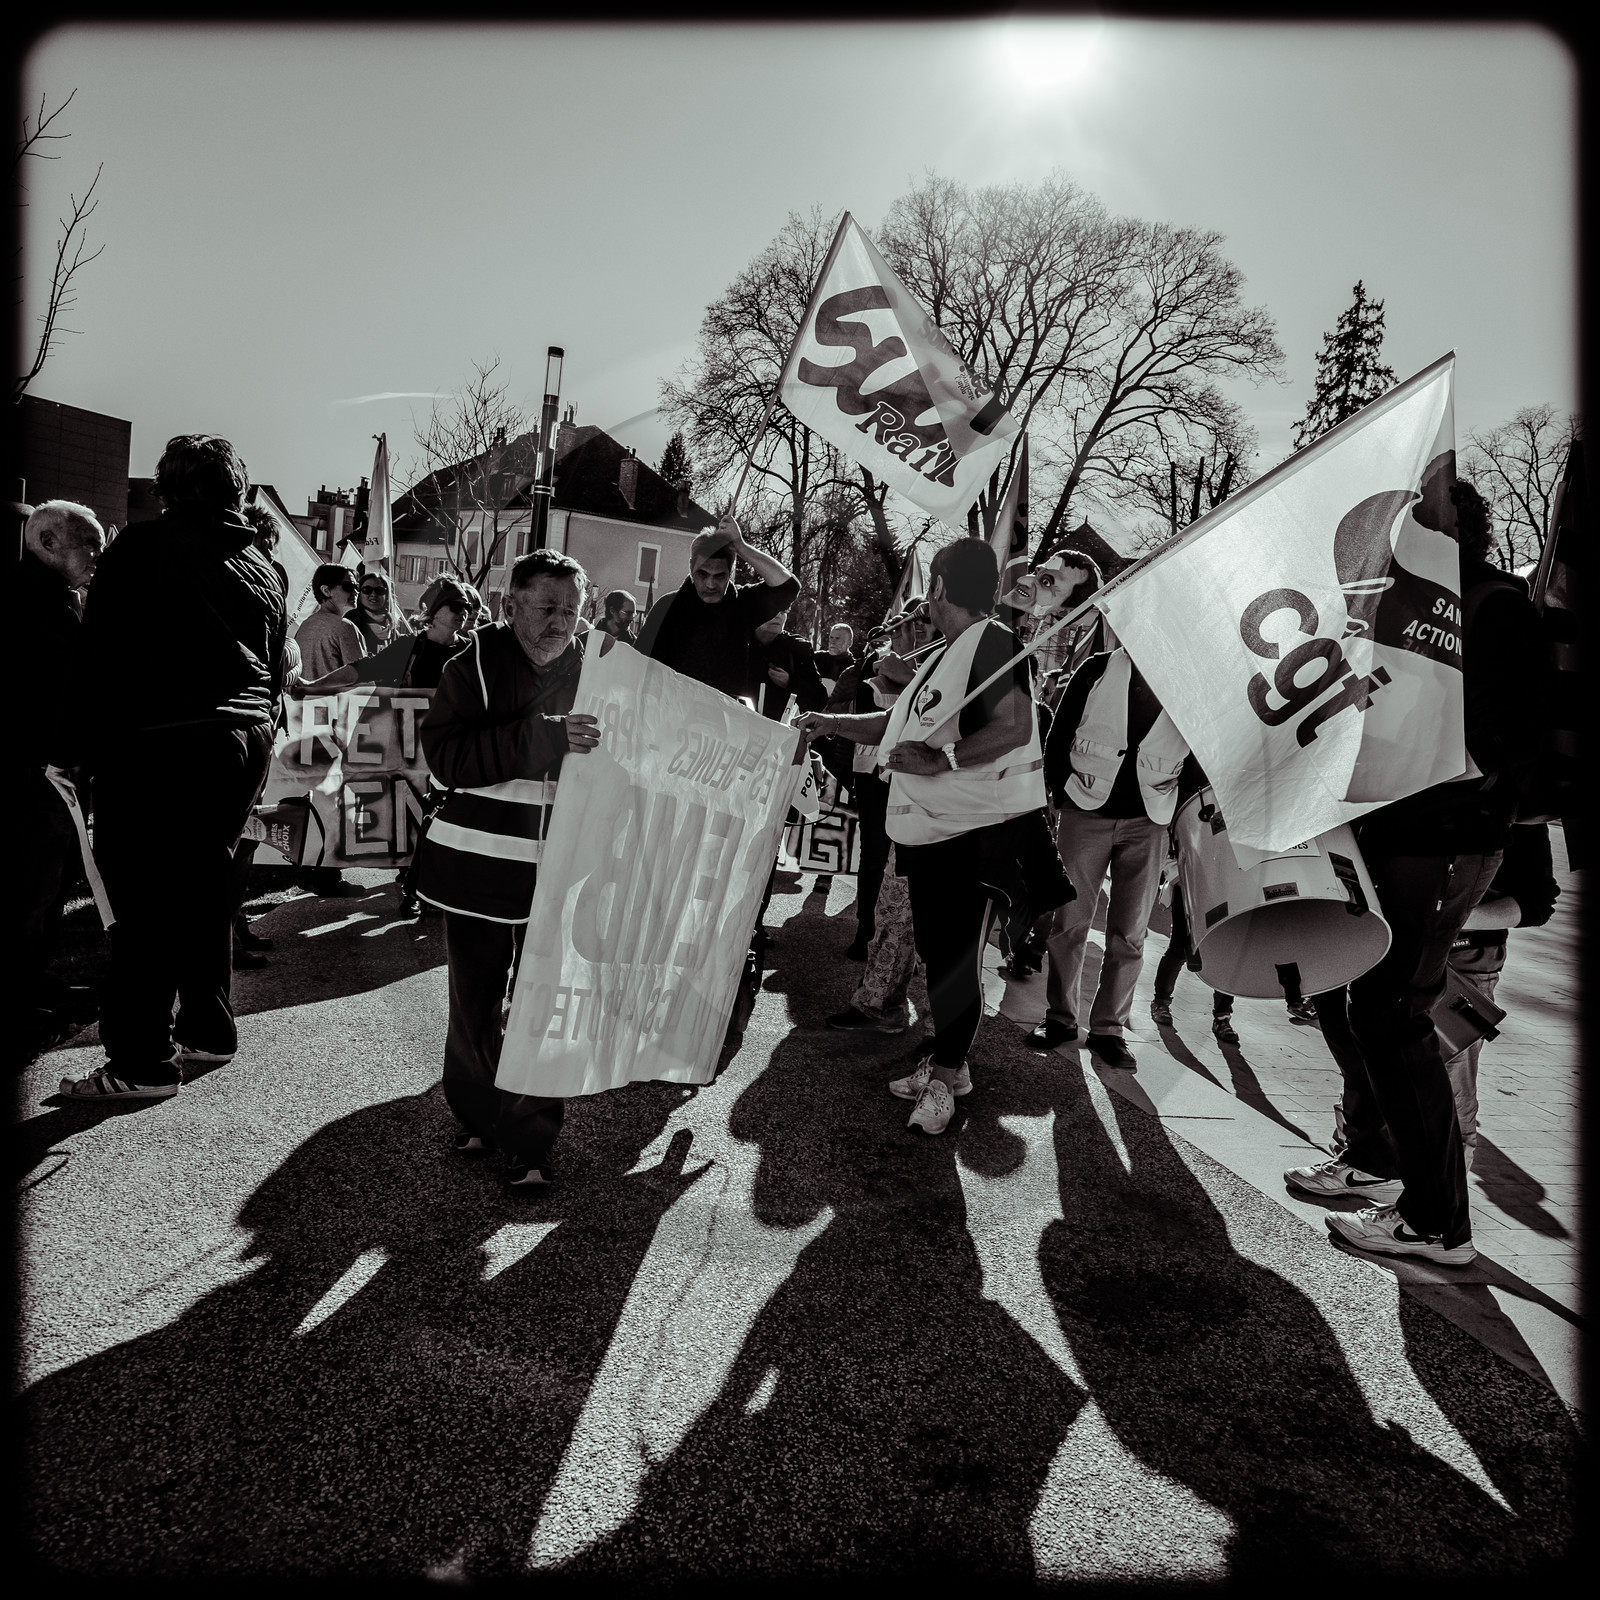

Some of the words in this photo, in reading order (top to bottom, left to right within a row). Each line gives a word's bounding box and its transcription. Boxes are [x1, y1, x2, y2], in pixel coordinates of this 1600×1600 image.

[855, 401, 962, 487] Rail
[1402, 619, 1462, 656] ACTION
[1432, 597, 1462, 627] SAN
[1239, 588, 1392, 749] cgt
[300, 694, 430, 765] RET
[281, 824, 291, 852] CHOIX
